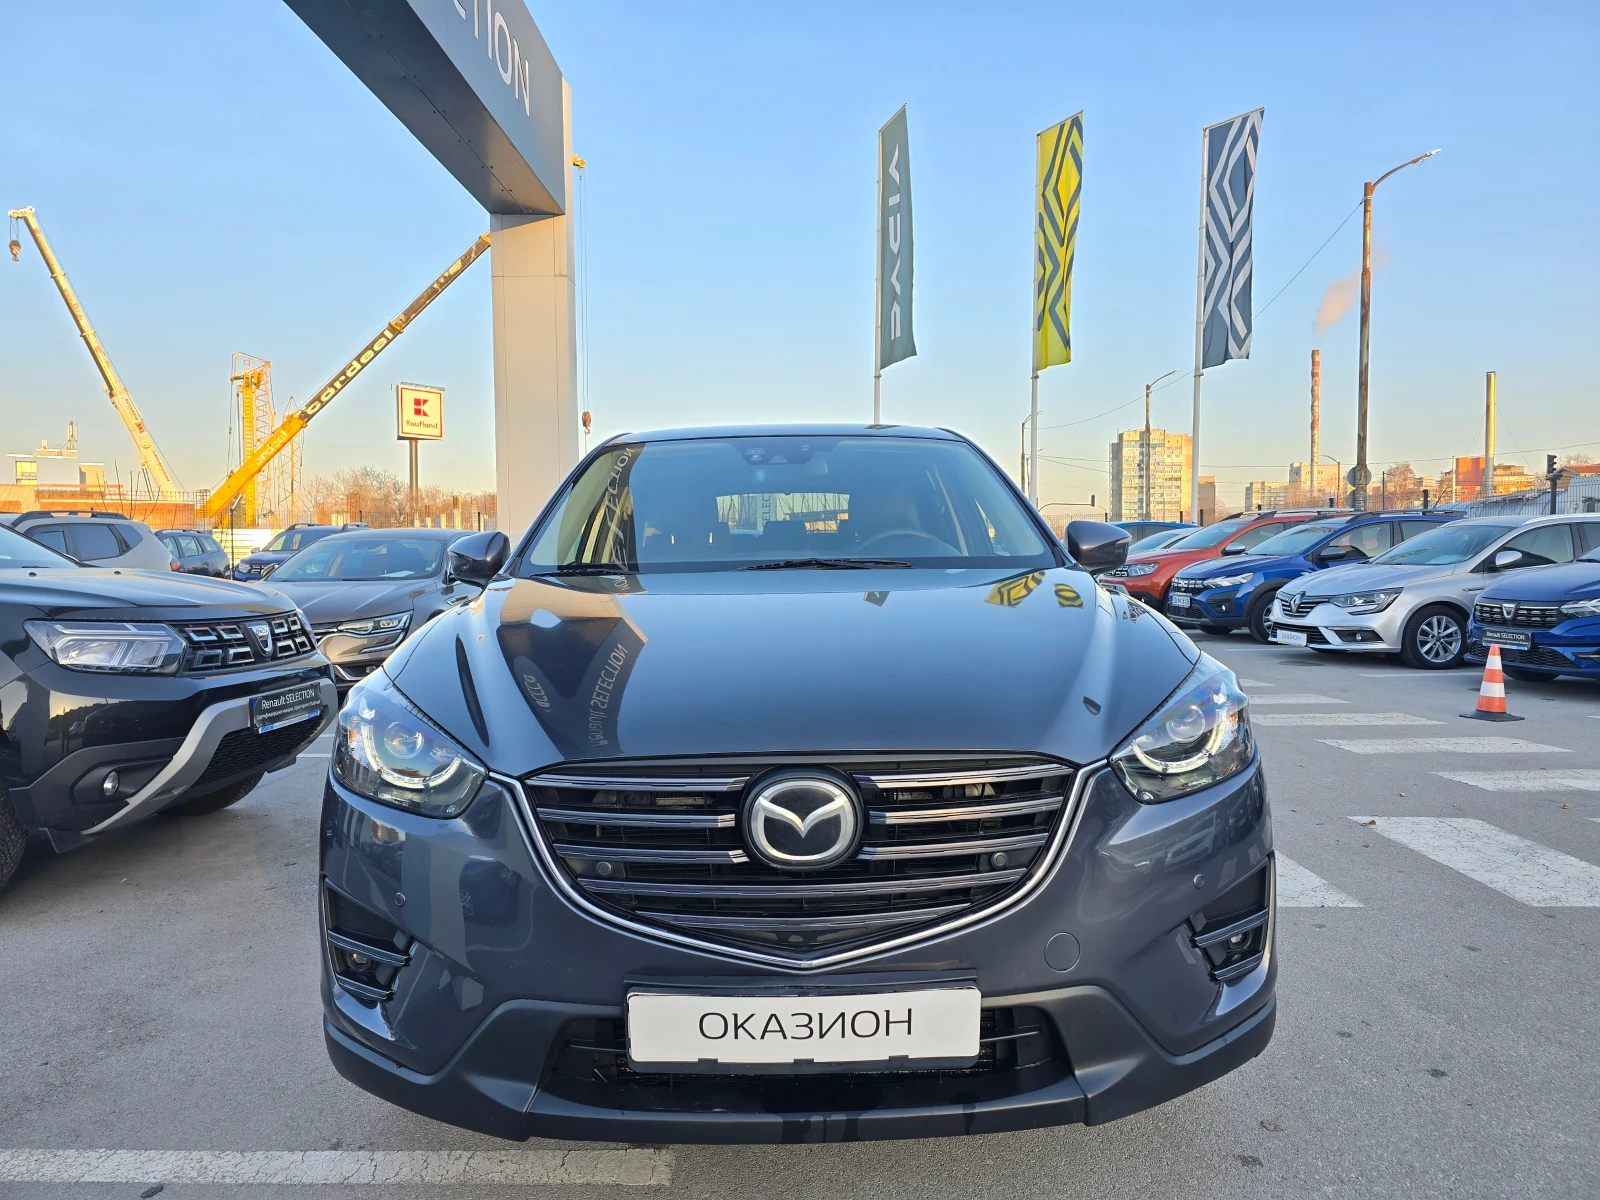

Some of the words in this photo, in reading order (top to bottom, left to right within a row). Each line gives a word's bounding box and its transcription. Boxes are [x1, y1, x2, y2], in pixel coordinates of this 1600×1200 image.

[888, 143, 901, 340] DACIA
[306, 329, 393, 414] cordeel
[405, 418, 438, 430] Kaufland
[261, 695, 286, 709] Renault
[285, 688, 315, 704] SELECTION
[699, 1008, 913, 1040] ОКАЗИОН
